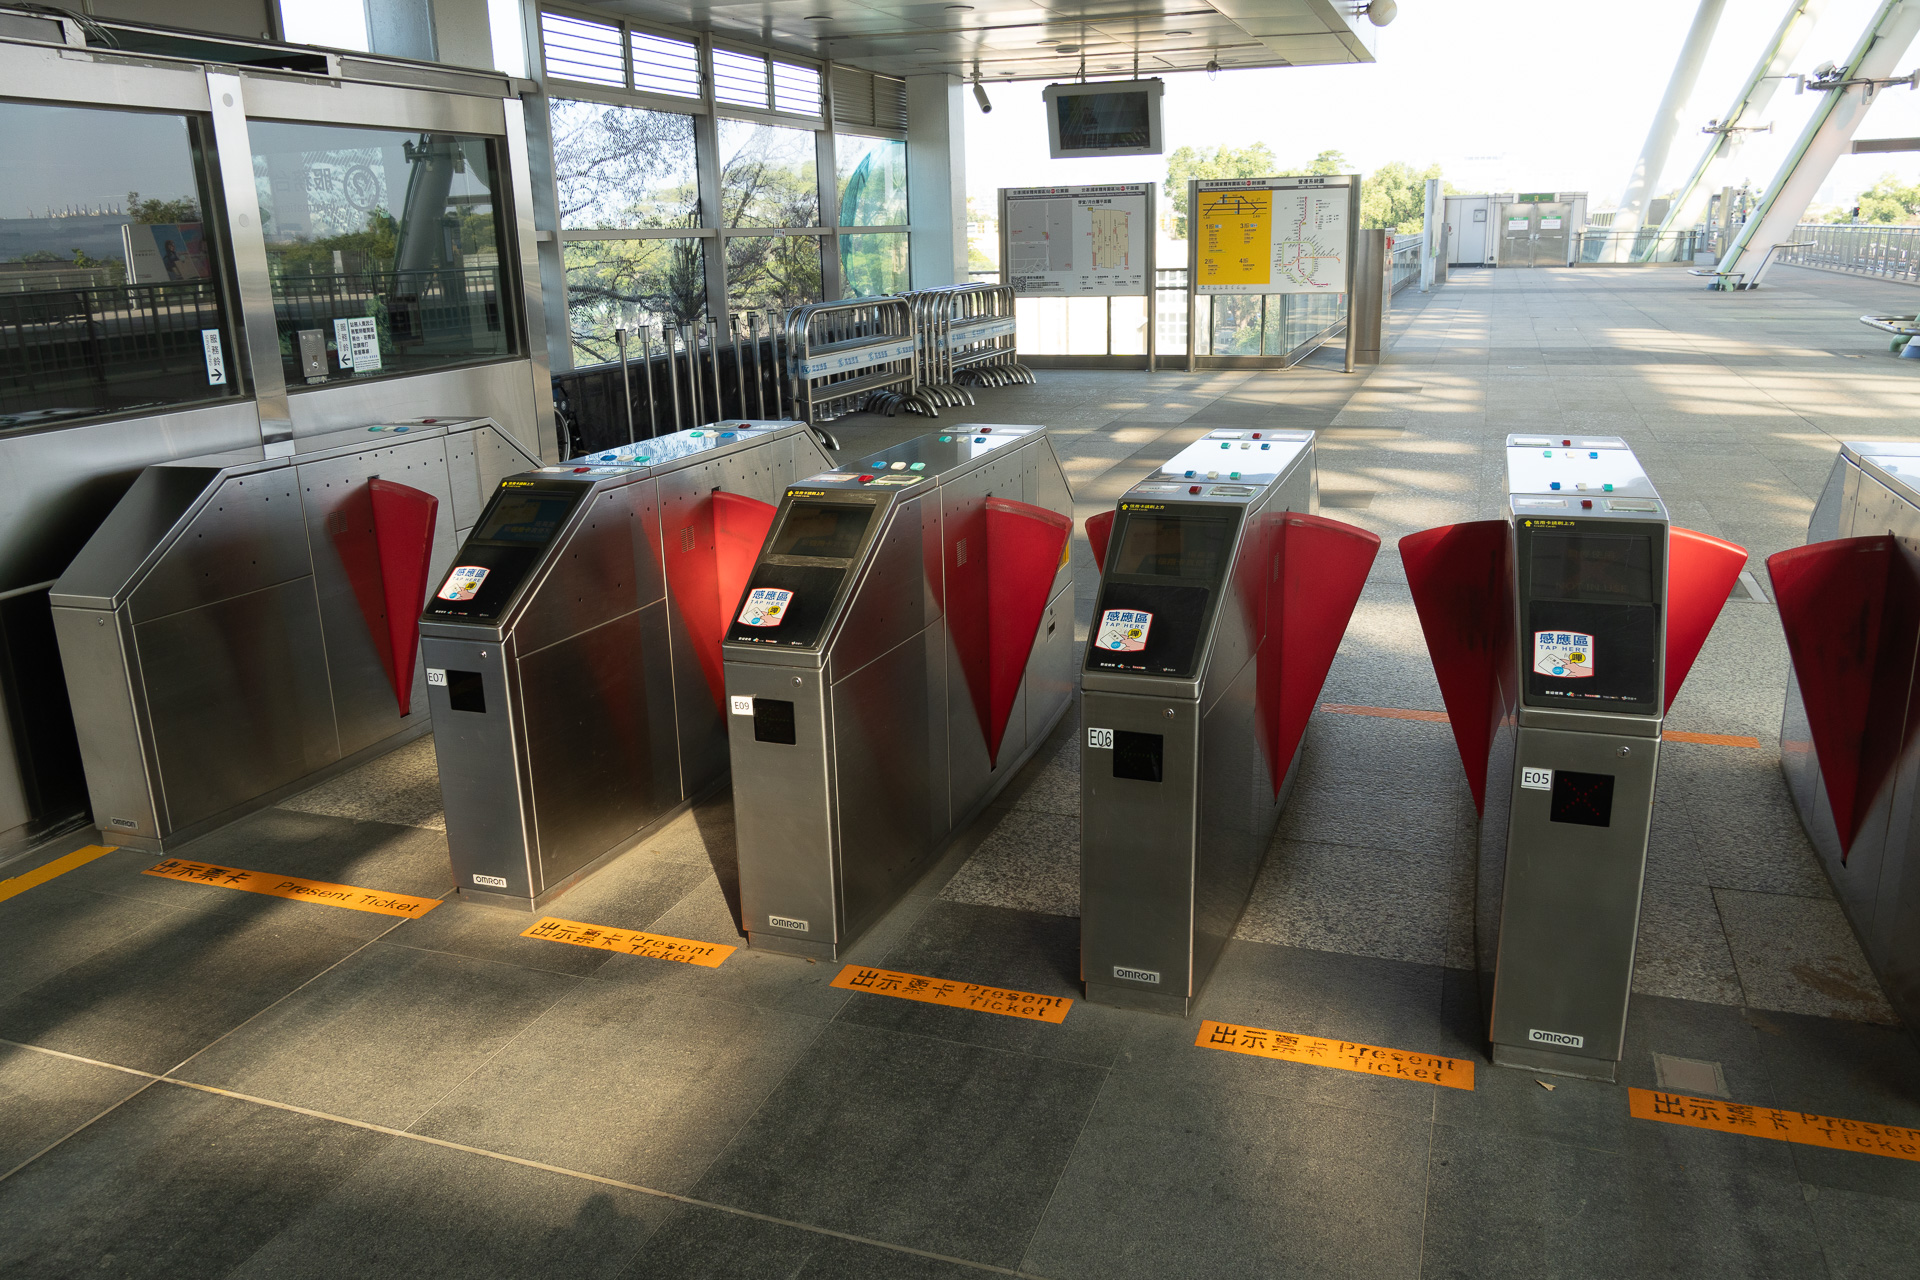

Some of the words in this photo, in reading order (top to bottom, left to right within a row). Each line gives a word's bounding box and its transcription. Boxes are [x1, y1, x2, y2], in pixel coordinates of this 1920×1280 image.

[455, 568, 488, 578] 感應區
[753, 590, 790, 601] 感應區
[1107, 611, 1149, 623] 感應區
[1540, 633, 1588, 646] 感應區
[428, 672, 444, 683] E07
[734, 701, 750, 711] E09
[1089, 729, 1112, 747] E06
[1524, 771, 1549, 785] E05
[112, 818, 136, 828] OMRON
[149, 860, 252, 886] 出示票卡
[273, 881, 354, 902] Present
[360, 894, 421, 913] Ticket
[475, 875, 505, 886] OMRON
[771, 918, 805, 930] OMRON
[530, 922, 623, 947] 出示票卡
[629, 934, 715, 957] Present
[630, 944, 696, 964] Ticket
[1116, 969, 1156, 982] OMRON
[850, 969, 955, 998] 出示票卡
[963, 984, 1064, 1008] Present
[969, 995, 1046, 1017] Ticket
[1533, 1031, 1580, 1045] OMRON
[1339, 1042, 1455, 1071] Present
[1349, 1055, 1442, 1082] Ticket
